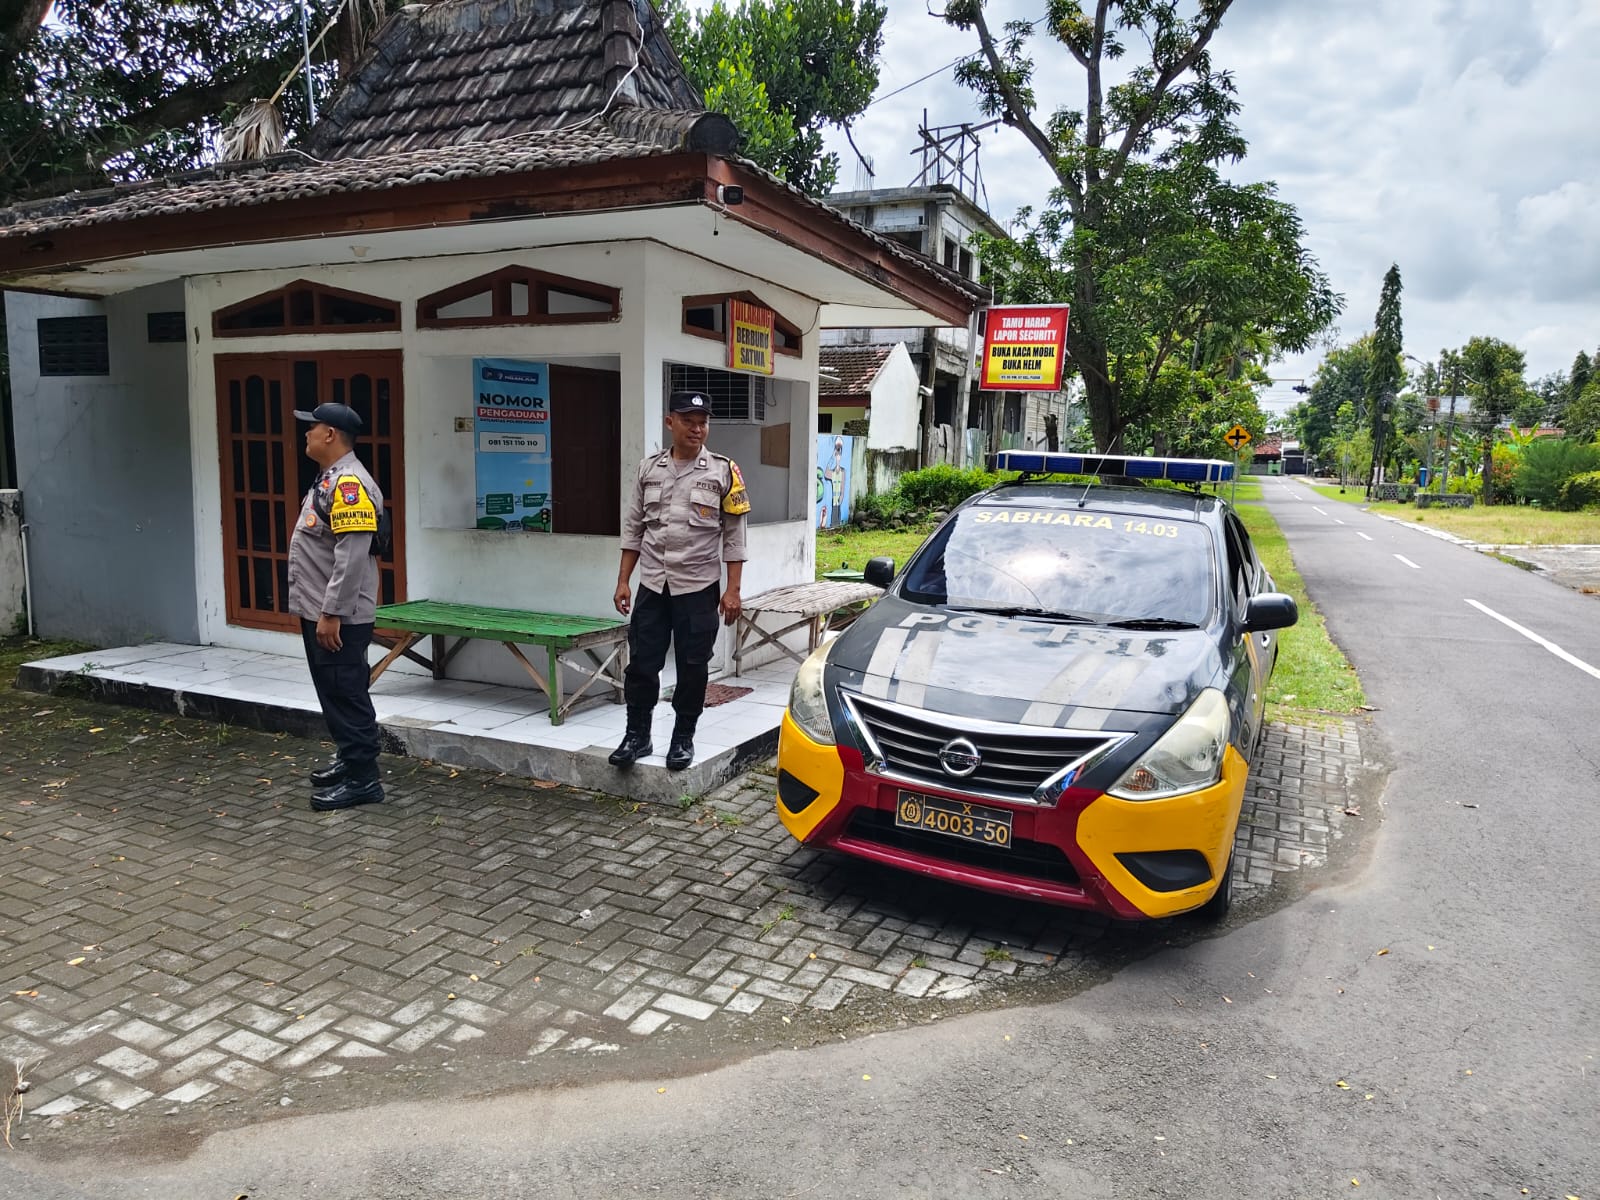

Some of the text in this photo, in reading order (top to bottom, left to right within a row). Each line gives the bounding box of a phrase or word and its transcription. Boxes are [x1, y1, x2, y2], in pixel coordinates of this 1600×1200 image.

[1002, 316, 1051, 329] TAMU HARAP
[736, 326, 769, 350] BERBURU
[993, 329, 1057, 341] LAPOR SECURITY
[740, 347, 766, 368] SATWA
[991, 346, 1055, 357] BUKA KACA MOBIL
[1002, 359, 1042, 370] BUKA HELM
[479, 392, 544, 409] NOMOR
[479, 408, 545, 420] PENGADUAN
[974, 511, 1179, 538] SABHARA 14.03
[898, 612, 1153, 656] POLISI
[962, 803, 972, 816] X
[924, 810, 1008, 844] 4003-50
